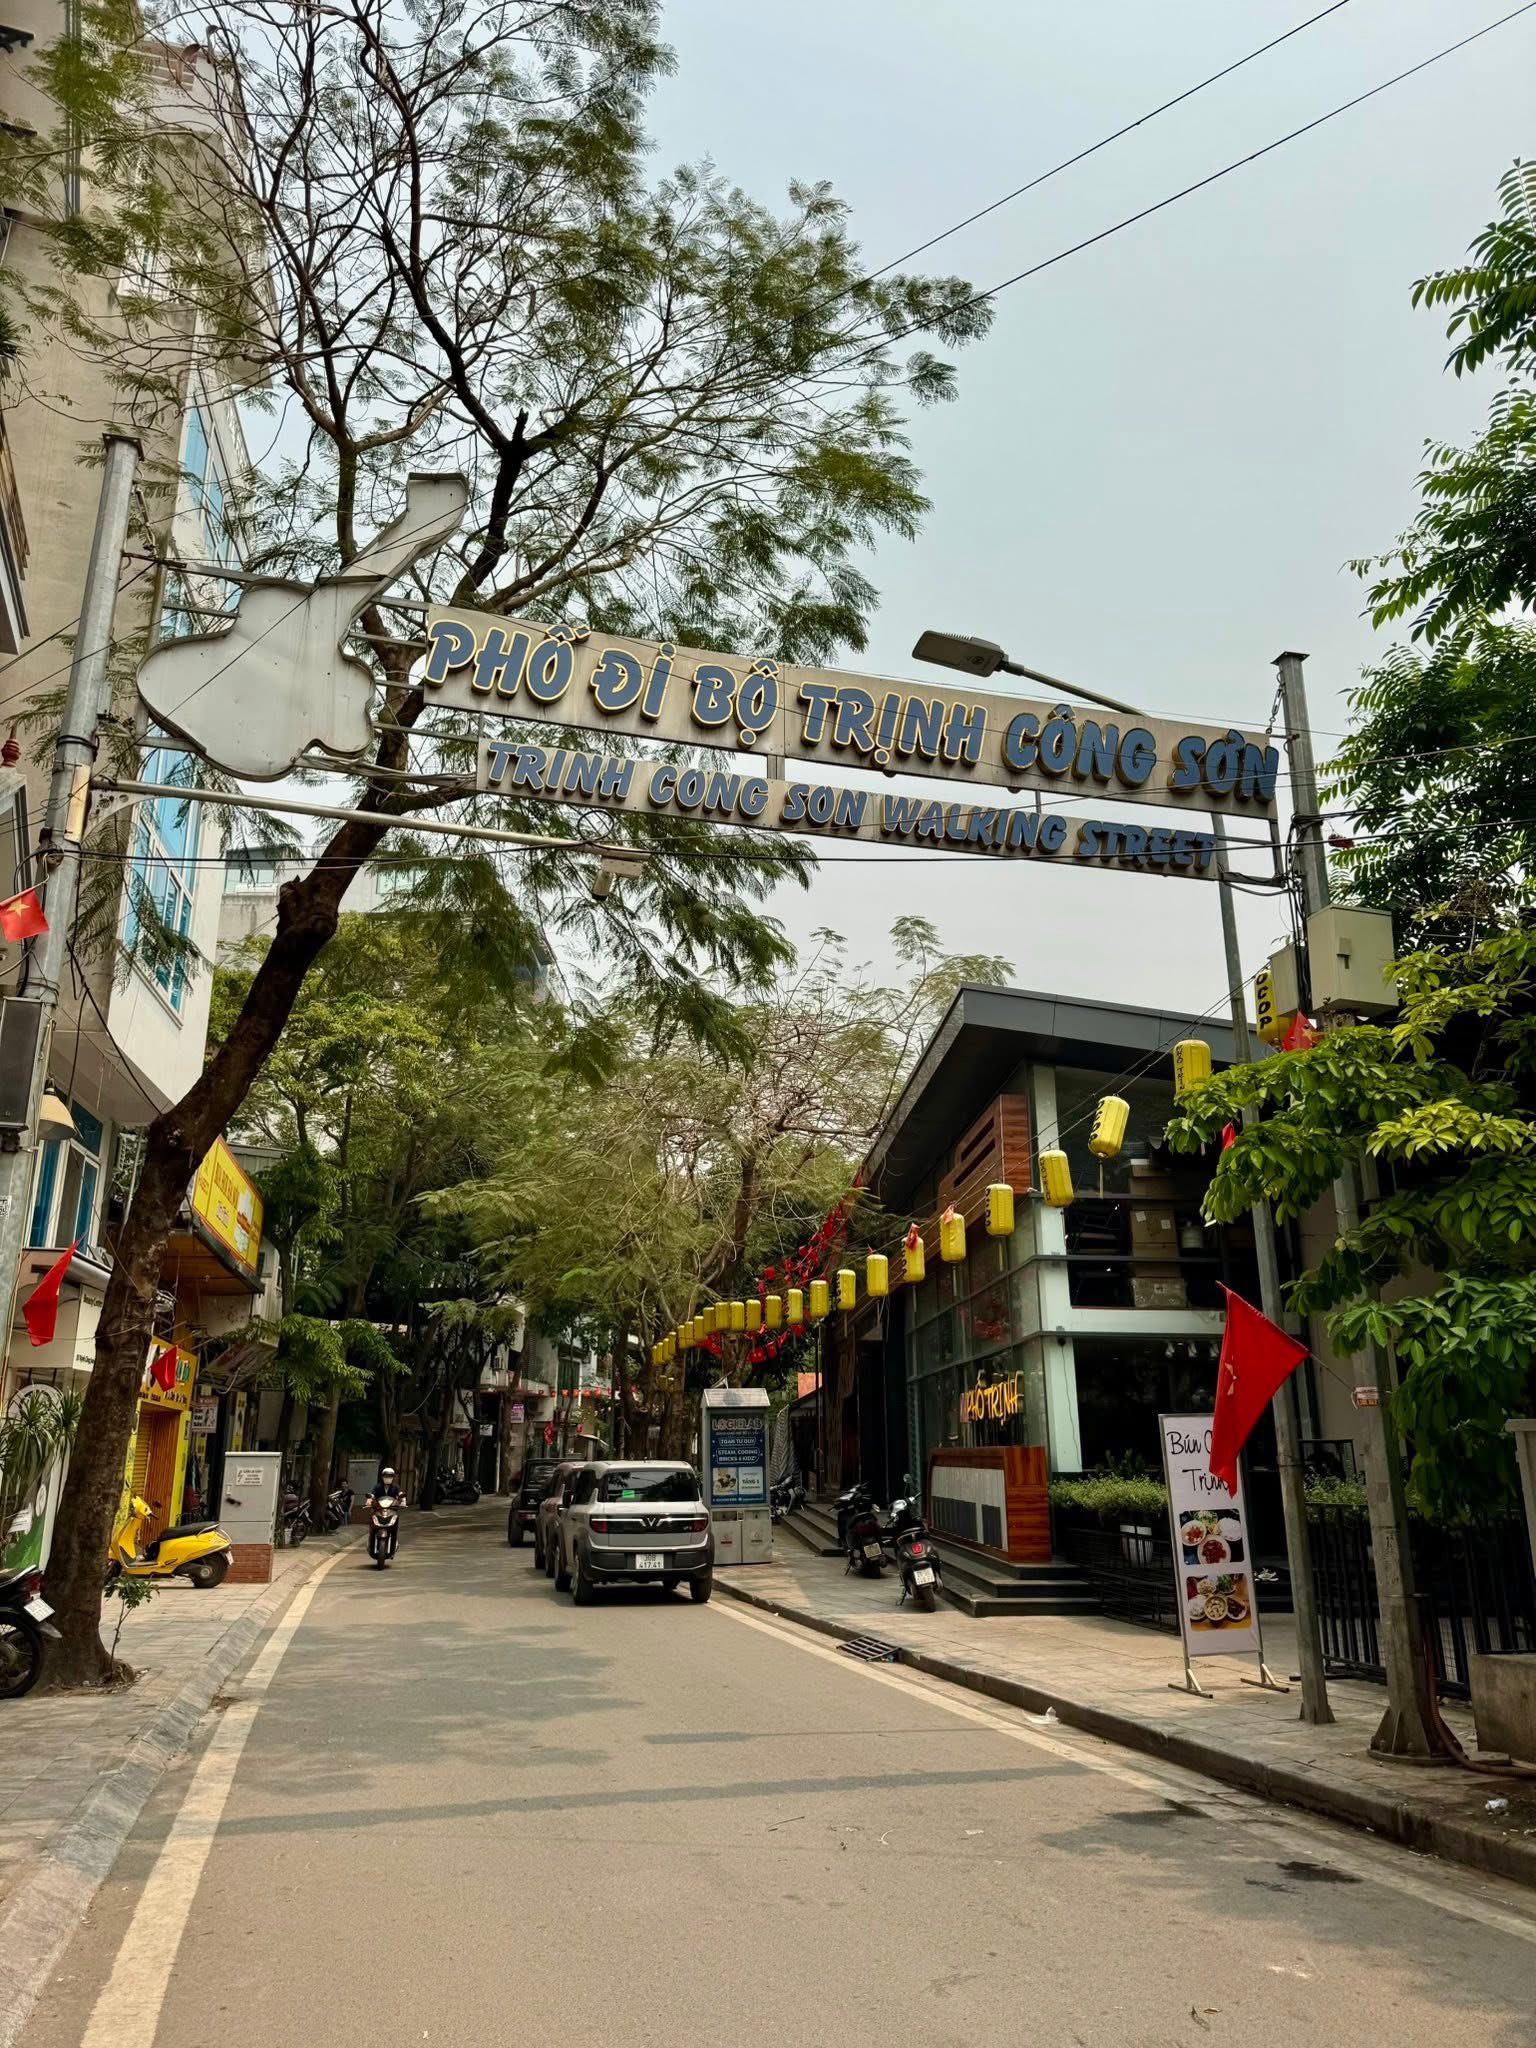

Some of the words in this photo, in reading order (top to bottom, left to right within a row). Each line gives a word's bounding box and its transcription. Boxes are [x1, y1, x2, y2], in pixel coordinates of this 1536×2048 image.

[424, 619, 591, 703] PHỐ
[692, 657, 781, 747] BỘ
[799, 681, 988, 765] TRỊNH
[1003, 703, 1157, 787] CÔNG
[1169, 729, 1279, 803] SƠN
[488, 741, 635, 800] TRINH
[648, 764, 769, 817] CONG
[781, 783, 867, 831] SON
[880, 794, 1067, 853] WALKING
[1076, 820, 1217, 870] STREET
[1256, 972, 1273, 1030] OCOP
[1166, 1430, 1202, 1455] Bún
